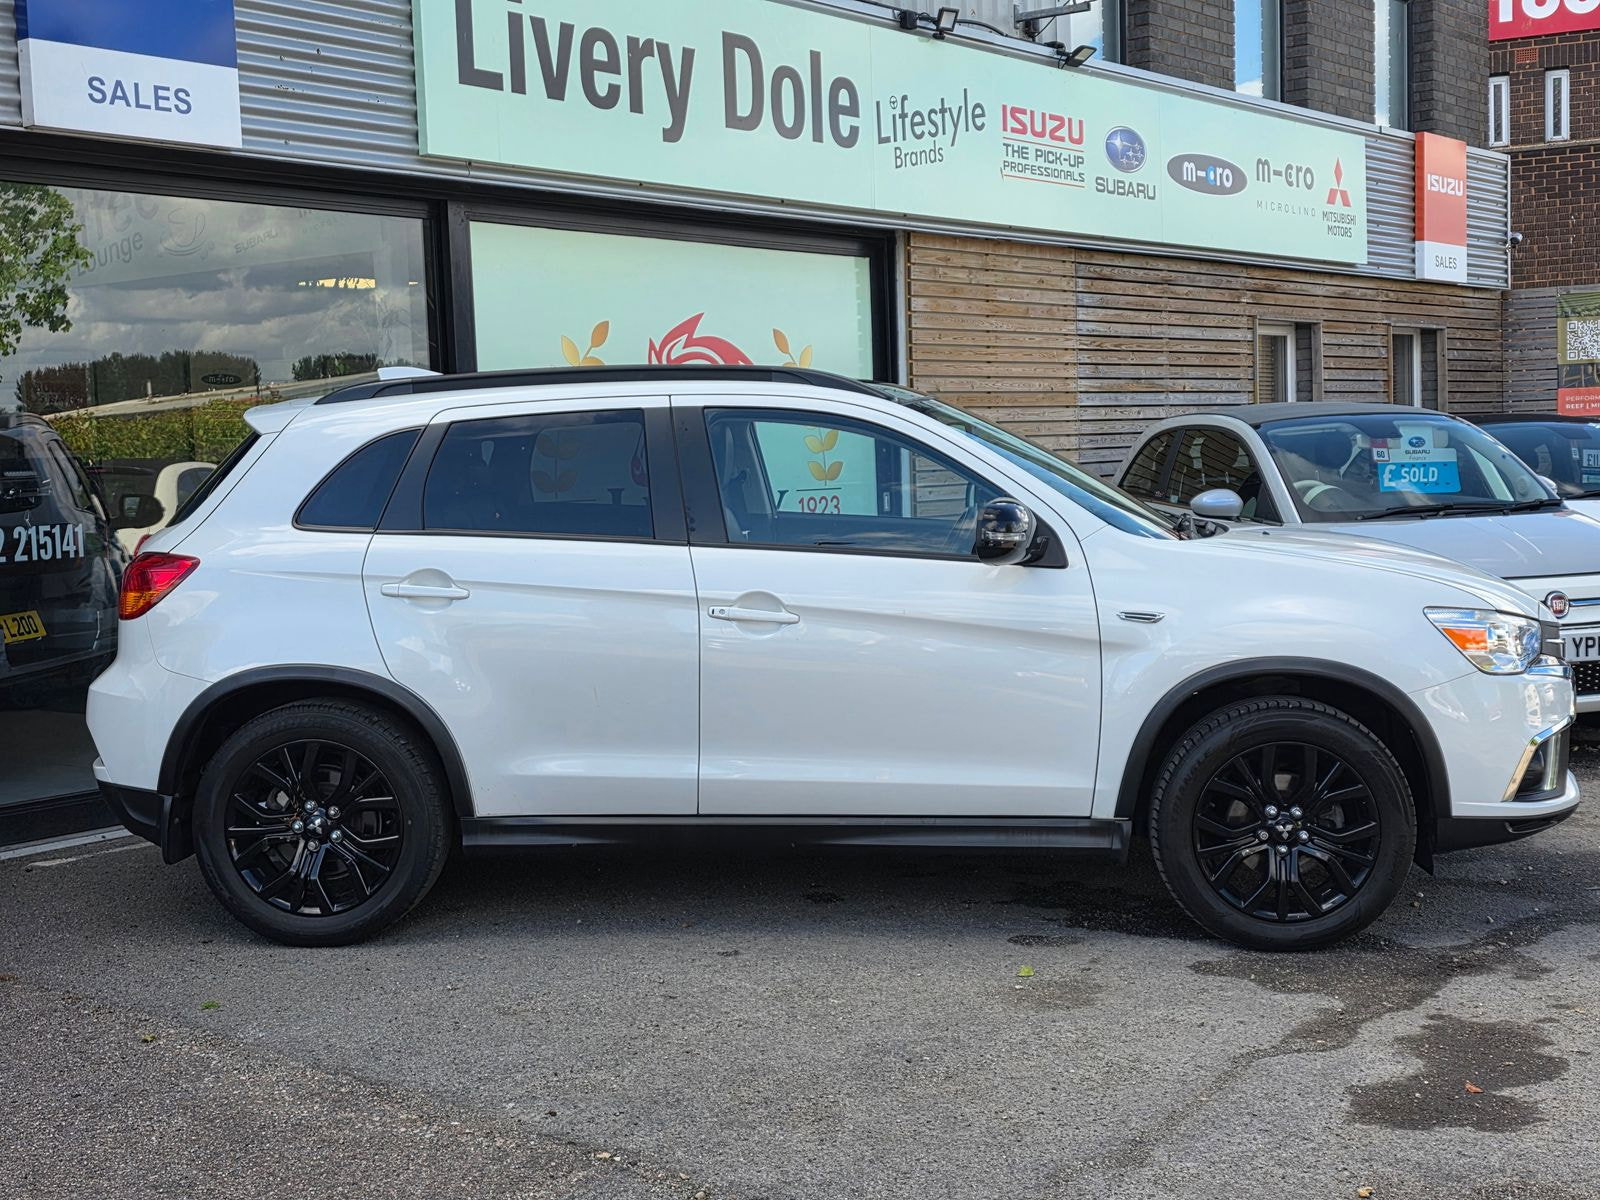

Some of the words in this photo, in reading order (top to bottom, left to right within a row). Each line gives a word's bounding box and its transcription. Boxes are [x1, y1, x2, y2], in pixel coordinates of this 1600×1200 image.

[454, 0, 696, 143] Livery
[721, 30, 861, 149] Dole
[87, 76, 193, 115] SALES
[876, 88, 986, 147] Lifestyle
[1001, 104, 1084, 145] ISUZU
[893, 141, 944, 169] Brands
[1003, 143, 1030, 161] THE
[1035, 149, 1085, 169] PICK-UP
[1003, 160, 1085, 183] PROFESSIONALS
[1095, 176, 1157, 201] SUBARU
[1427, 173, 1463, 197] ISUZU
[1256, 200, 1317, 218] MICROLINO
[1322, 210, 1357, 227] MITSUBISHI
[1327, 224, 1353, 239] MOTORS
[1435, 255, 1458, 270] SALES
[1401, 466, 1438, 483] SOLD
[798, 495, 841, 514] 1923
[13, 523, 86, 563] 215141
[3, 615, 40, 638] L200
